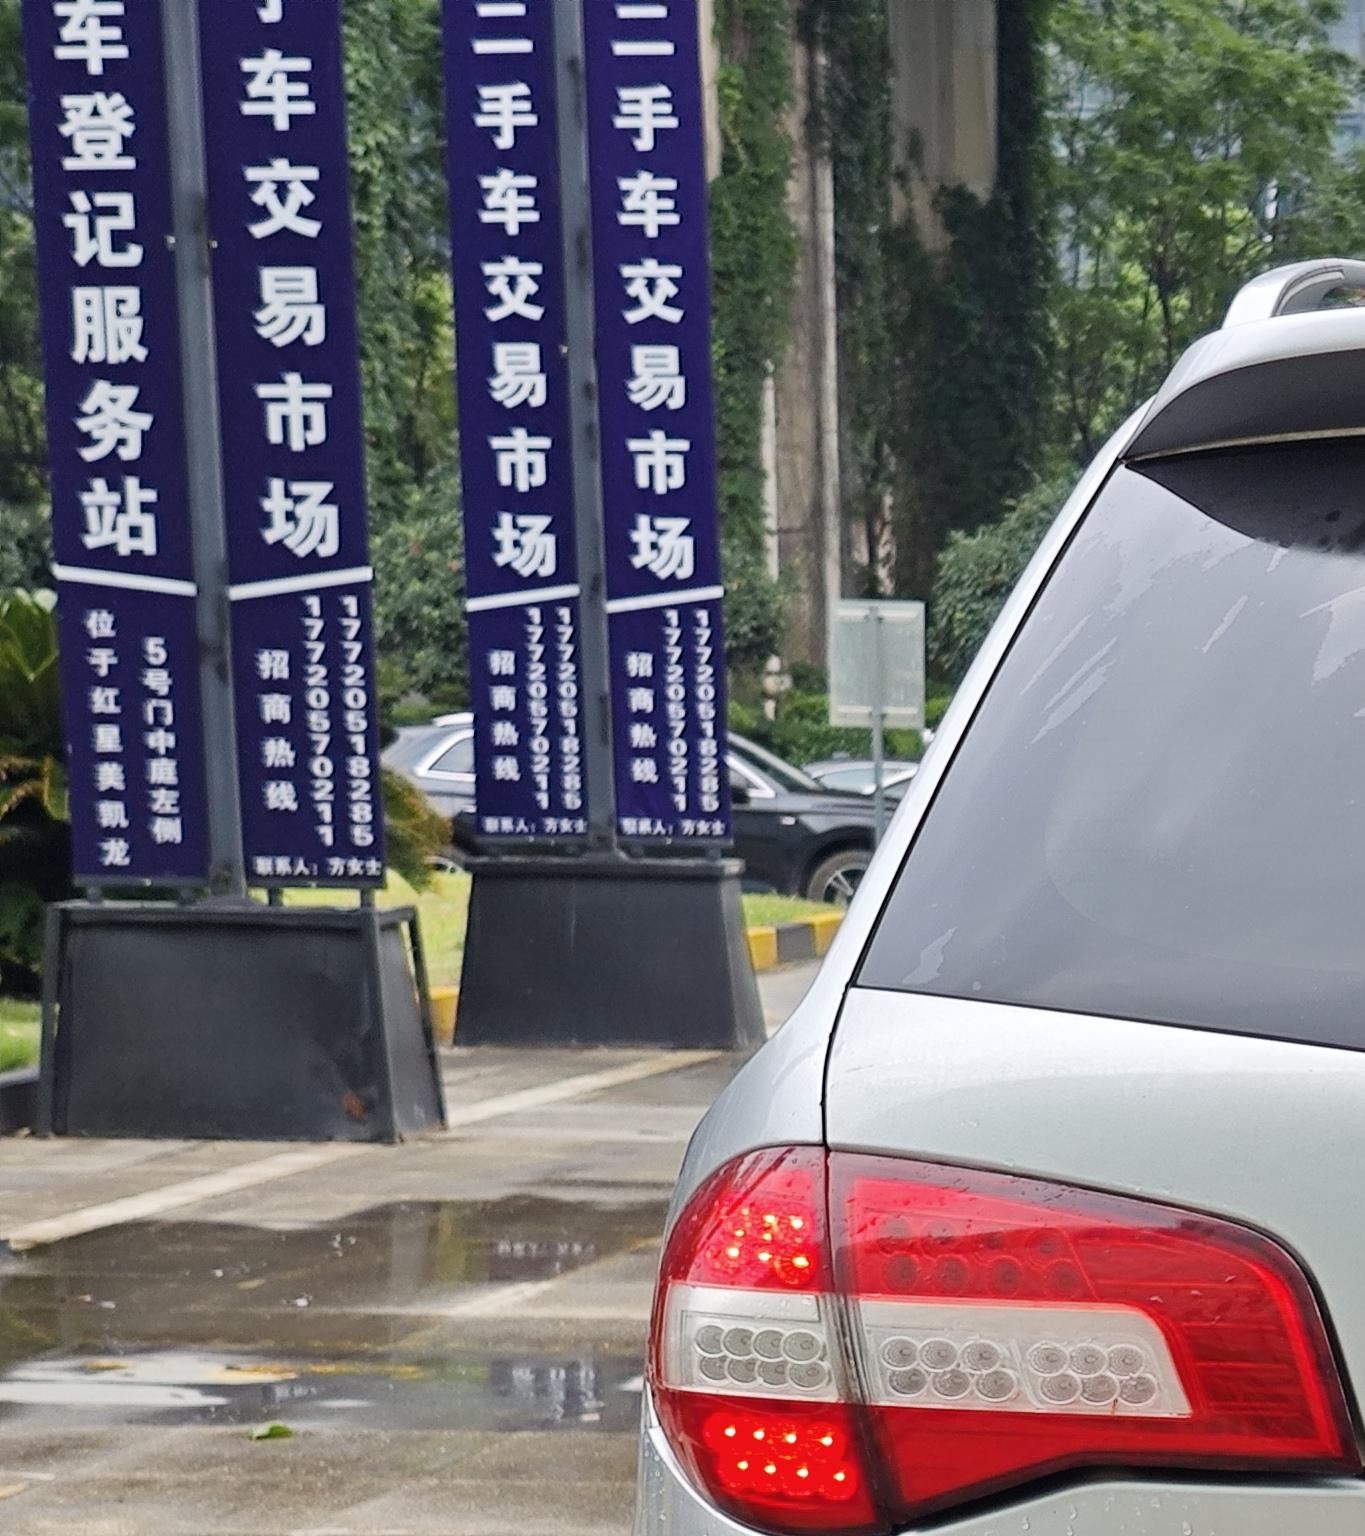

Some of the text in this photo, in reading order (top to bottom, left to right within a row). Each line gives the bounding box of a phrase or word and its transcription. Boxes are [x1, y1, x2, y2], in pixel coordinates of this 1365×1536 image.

[53, 0, 158, 557] 车登记服务站
[239, 0, 340, 559] 车交易市场
[471, 2, 558, 578] 二手车交易市场
[610, 3, 695, 581] 二手车交易市场
[86, 609, 130, 866] 位于红星美凯龙
[142, 636, 183, 845] 5号门中庭左侧
[257, 648, 298, 812] 招商热线
[303, 595, 334, 846] 17720570211
[341, 595, 374, 847] 17720518285
[488, 649, 521, 782] 招商热线
[527, 606, 551, 810] 17720570211
[627, 651, 659, 784] 招商热线
[664, 608, 688, 812] 17720570211
